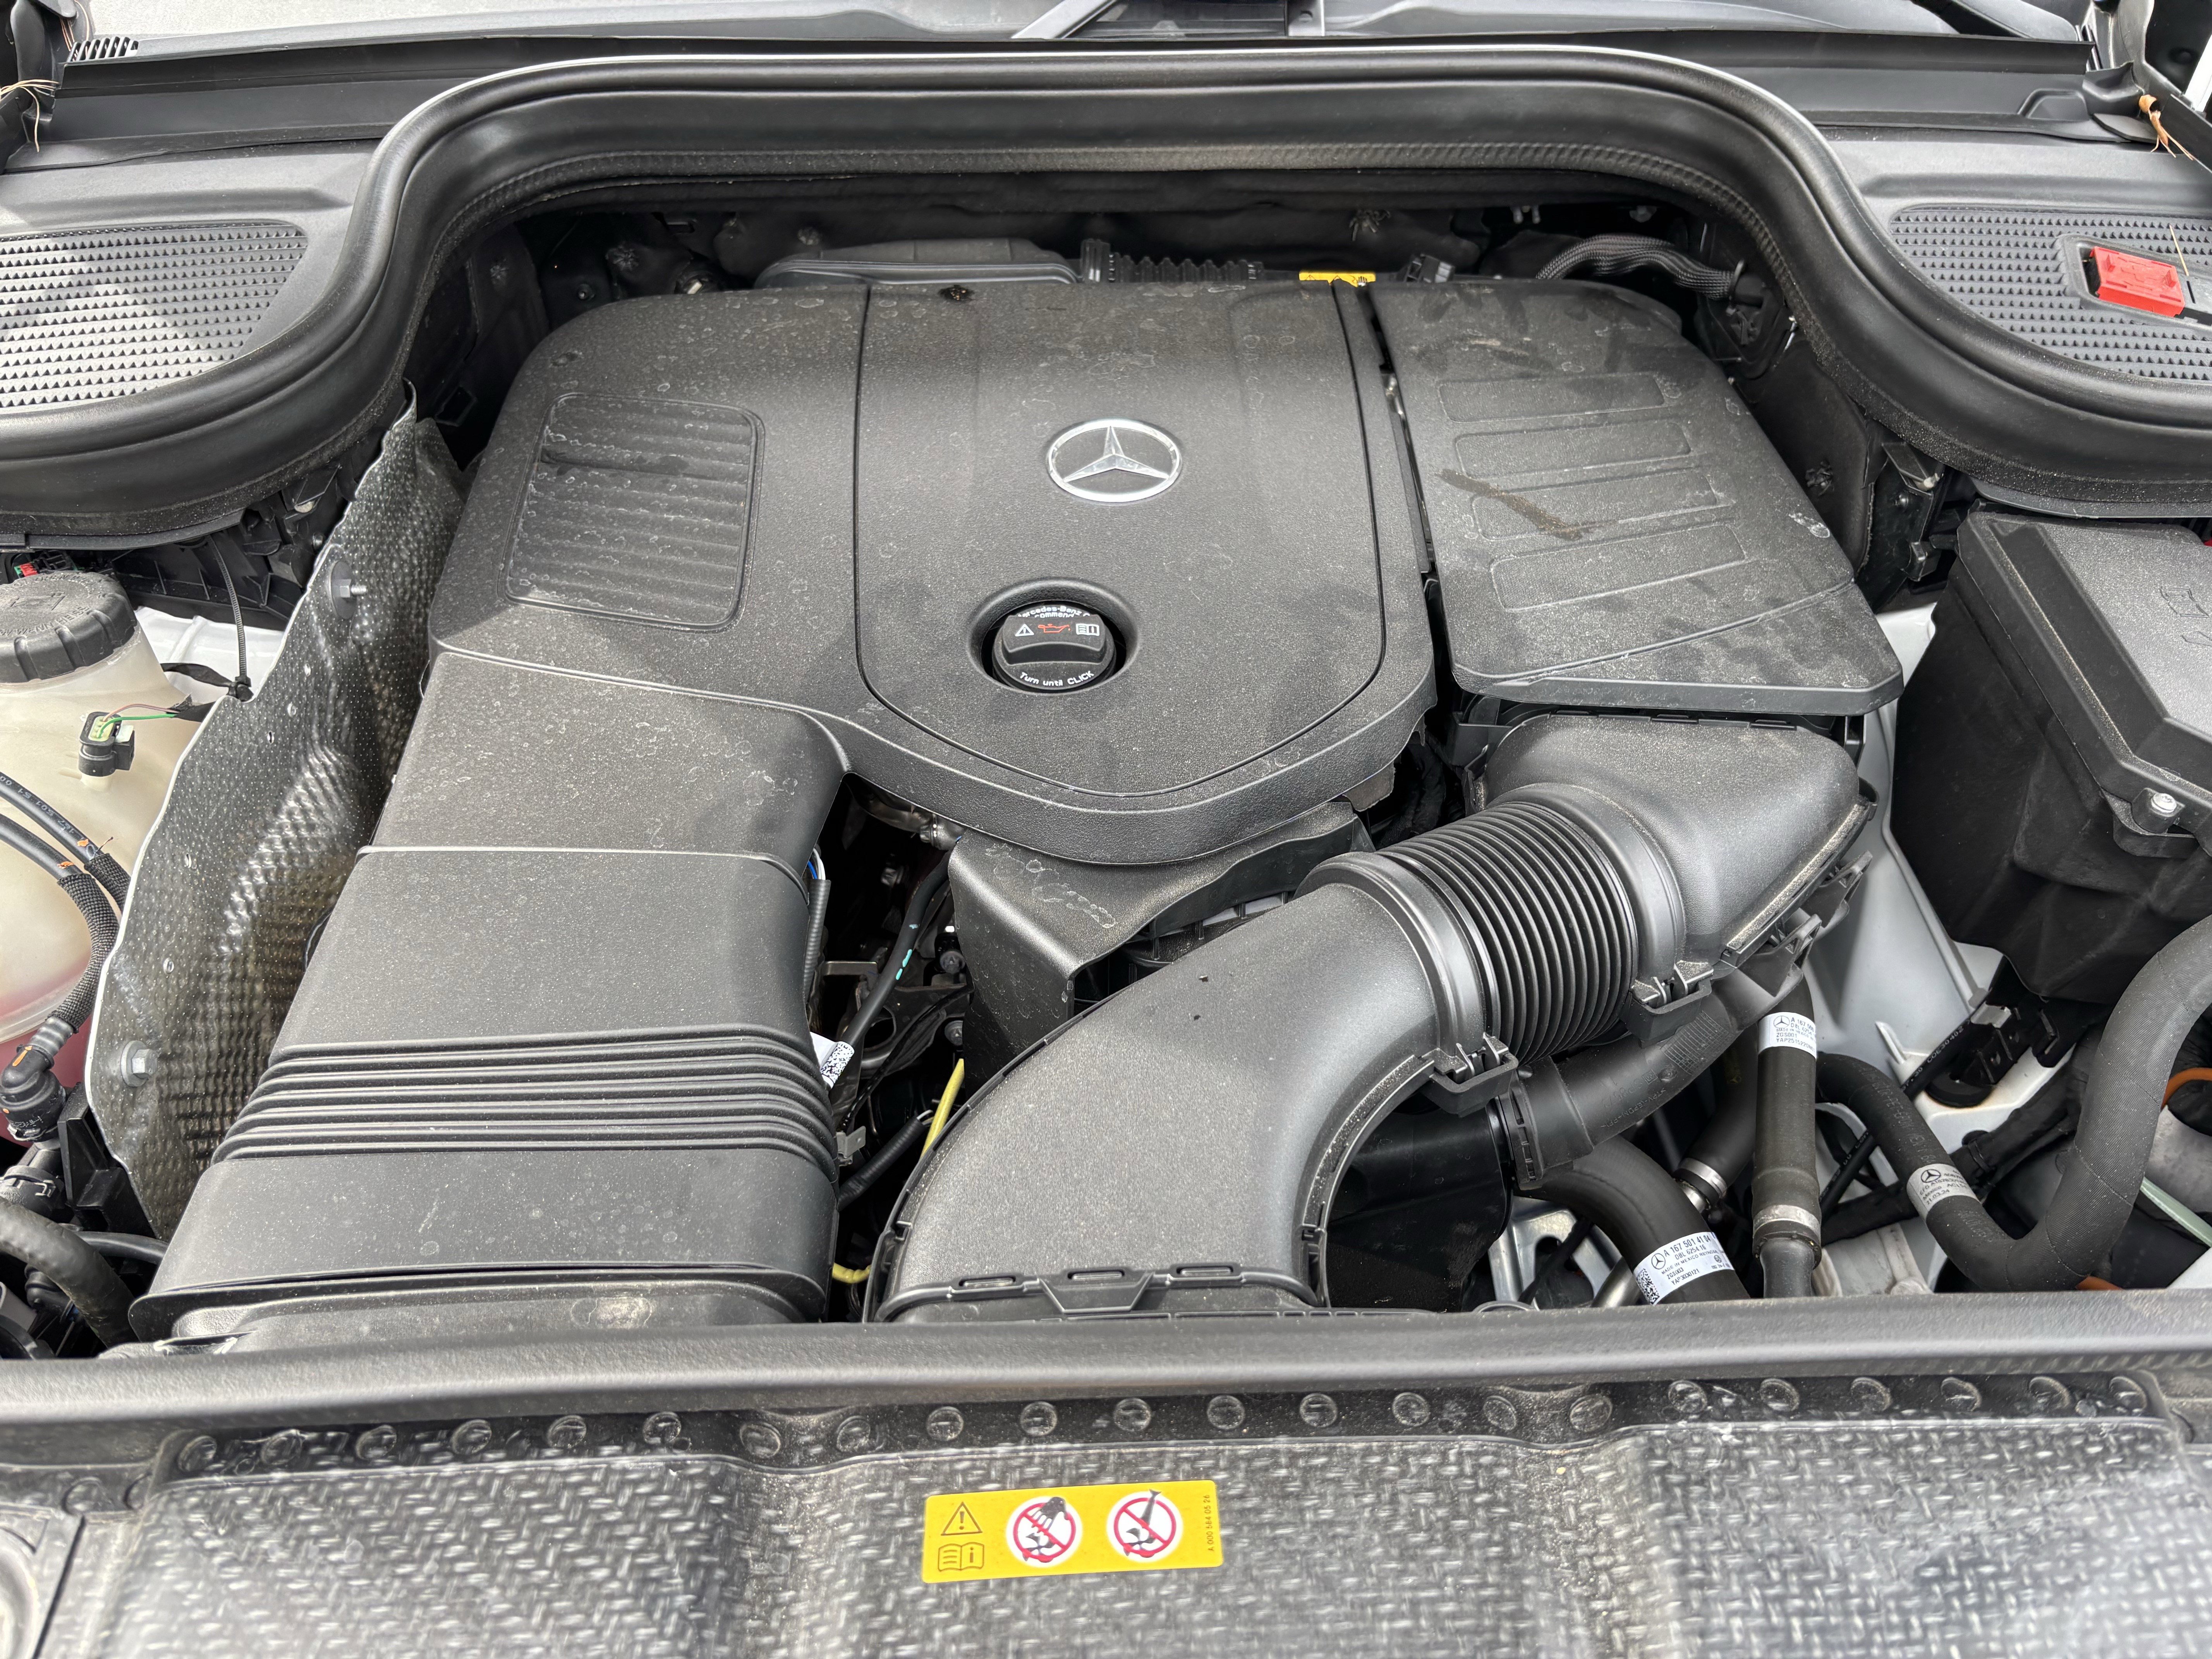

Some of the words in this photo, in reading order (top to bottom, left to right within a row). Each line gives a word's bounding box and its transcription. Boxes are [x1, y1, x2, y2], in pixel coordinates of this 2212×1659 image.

[1018, 606, 1082, 617] ercedes-Benz
[1020, 672, 1039, 684] Turn
[1067, 670, 1094, 685] CLICK
[1670, 1243, 1683, 1253] 167
[1683, 1238, 1696, 1248] 501
[1674, 1252, 1686, 1260] DBL
[1661, 1265, 1674, 1274] MADE
[1680, 1254, 1699, 1264] MEXICO
[1203, 1494, 1211, 1503] 26
[1204, 1505, 1211, 1514] 05
[1206, 1531, 1214, 1544] 000
